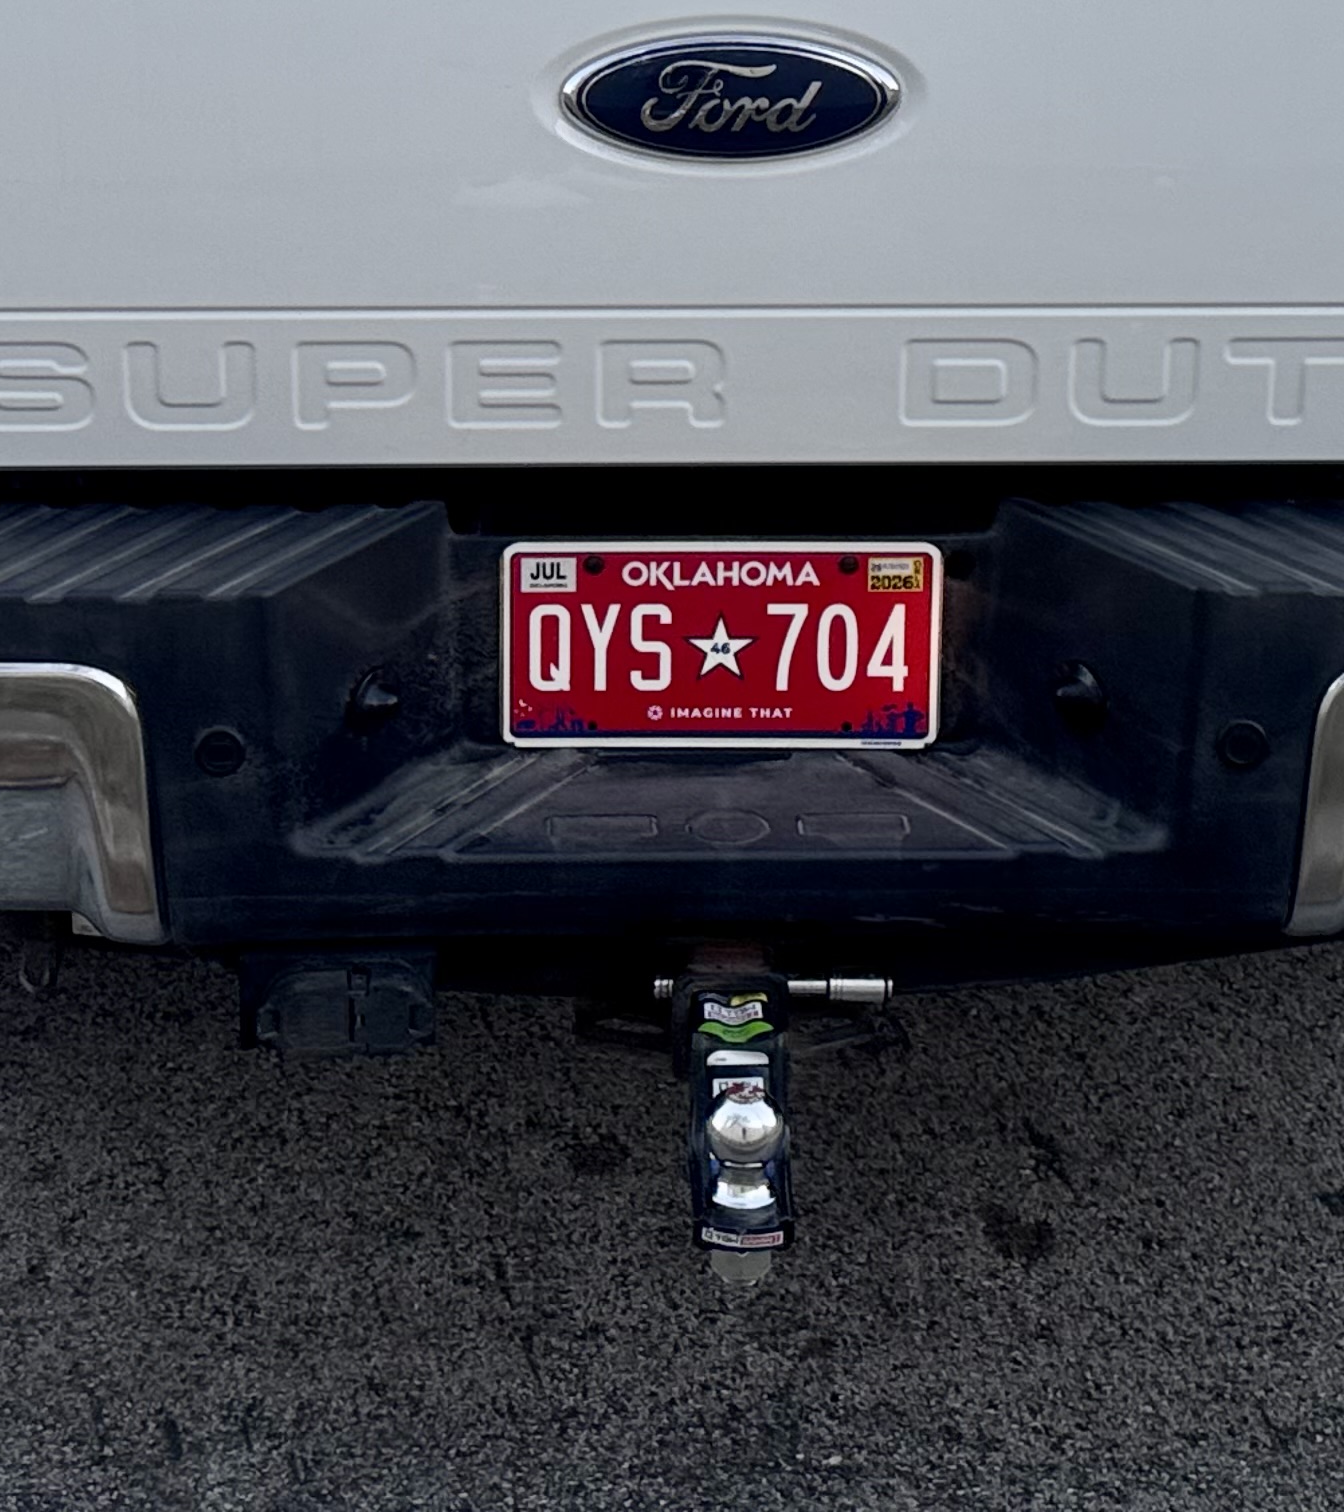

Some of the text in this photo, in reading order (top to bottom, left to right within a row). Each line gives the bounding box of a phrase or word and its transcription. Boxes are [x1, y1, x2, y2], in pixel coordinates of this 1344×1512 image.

[640, 59, 823, 133] Ford
[530, 561, 568, 580] JUL
[622, 560, 821, 590] OKLAHOMA
[870, 575, 914, 590] 2026
[529, 603, 909, 692] QYS 704
[710, 642, 731, 654] 46
[670, 707, 793, 719] IMAGINE THAT
